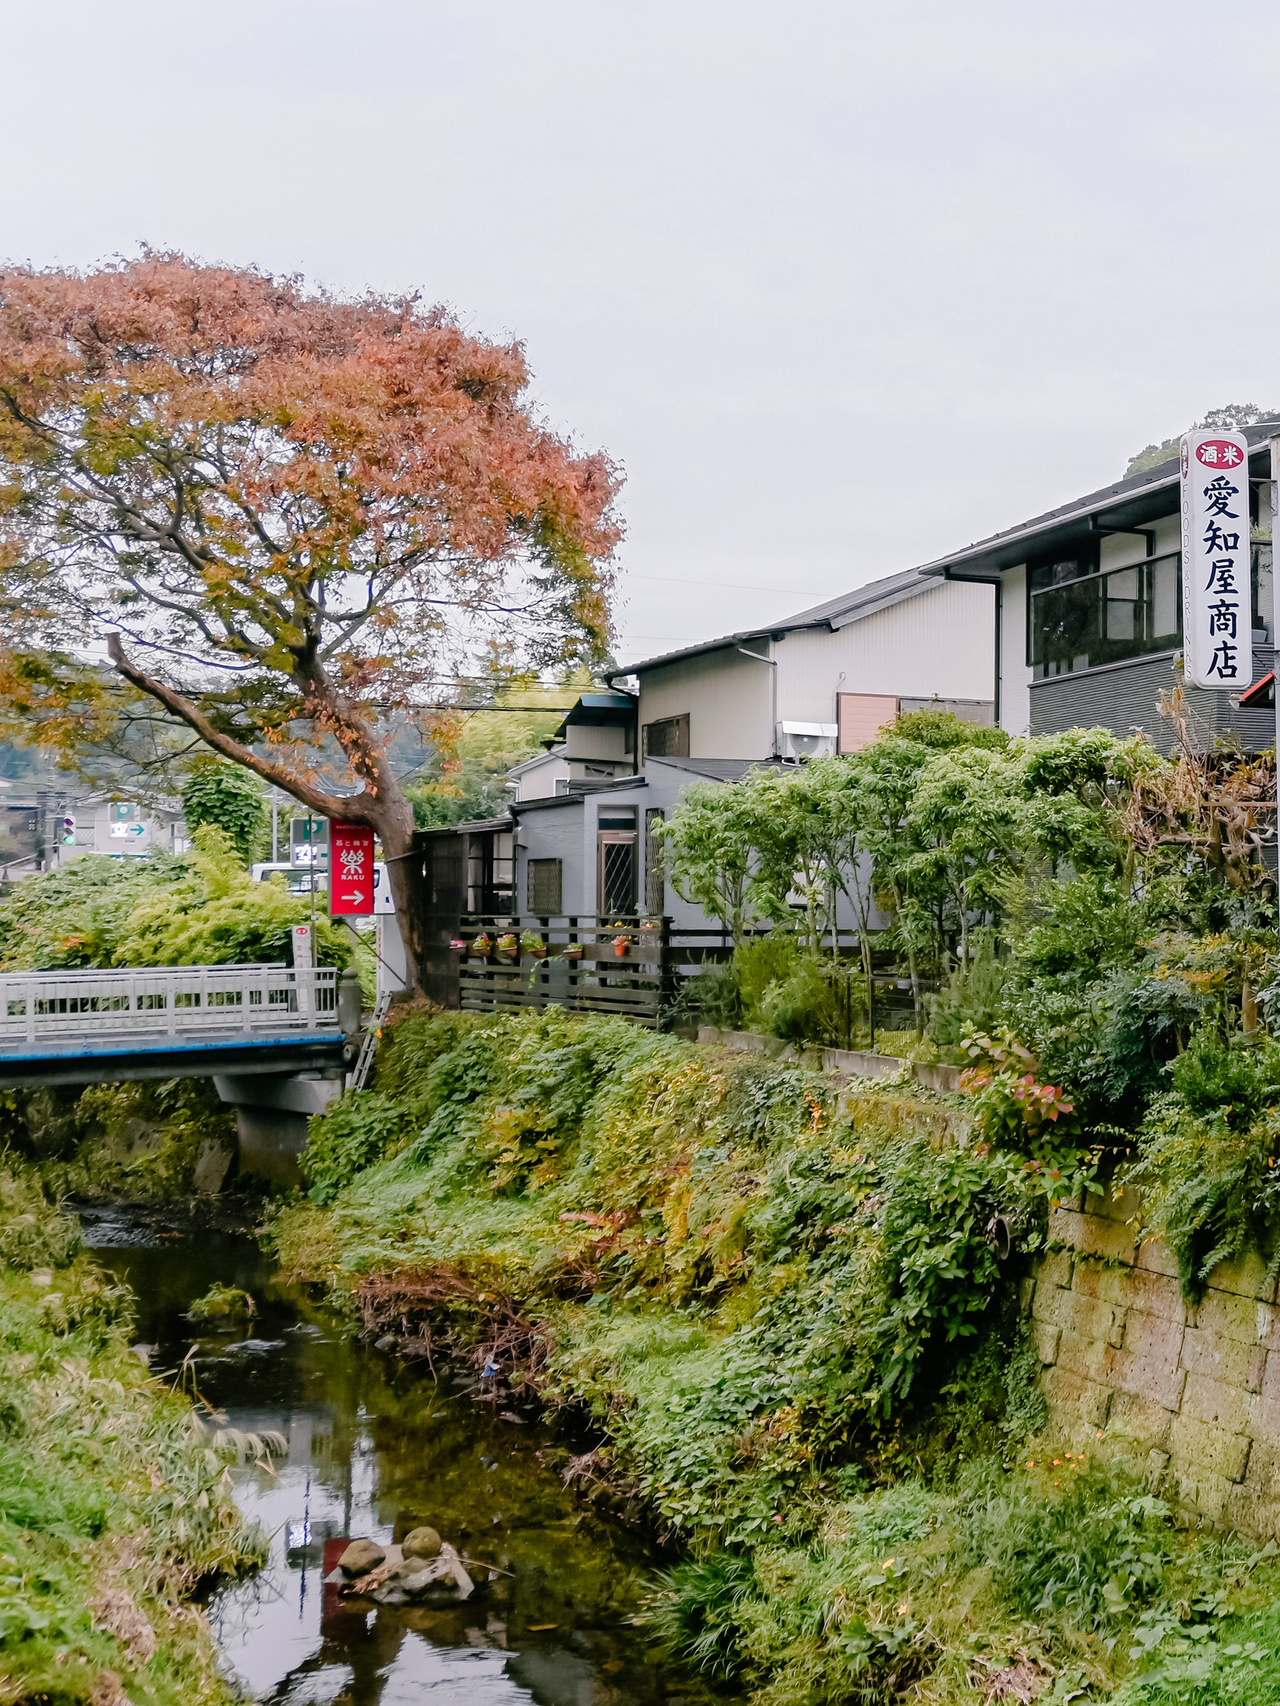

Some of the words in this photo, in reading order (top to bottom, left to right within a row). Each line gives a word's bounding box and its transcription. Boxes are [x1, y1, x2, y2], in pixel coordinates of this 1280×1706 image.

[1184, 585, 1192, 680] DRINKS
[1202, 475, 1240, 680] 愛知屋商店
